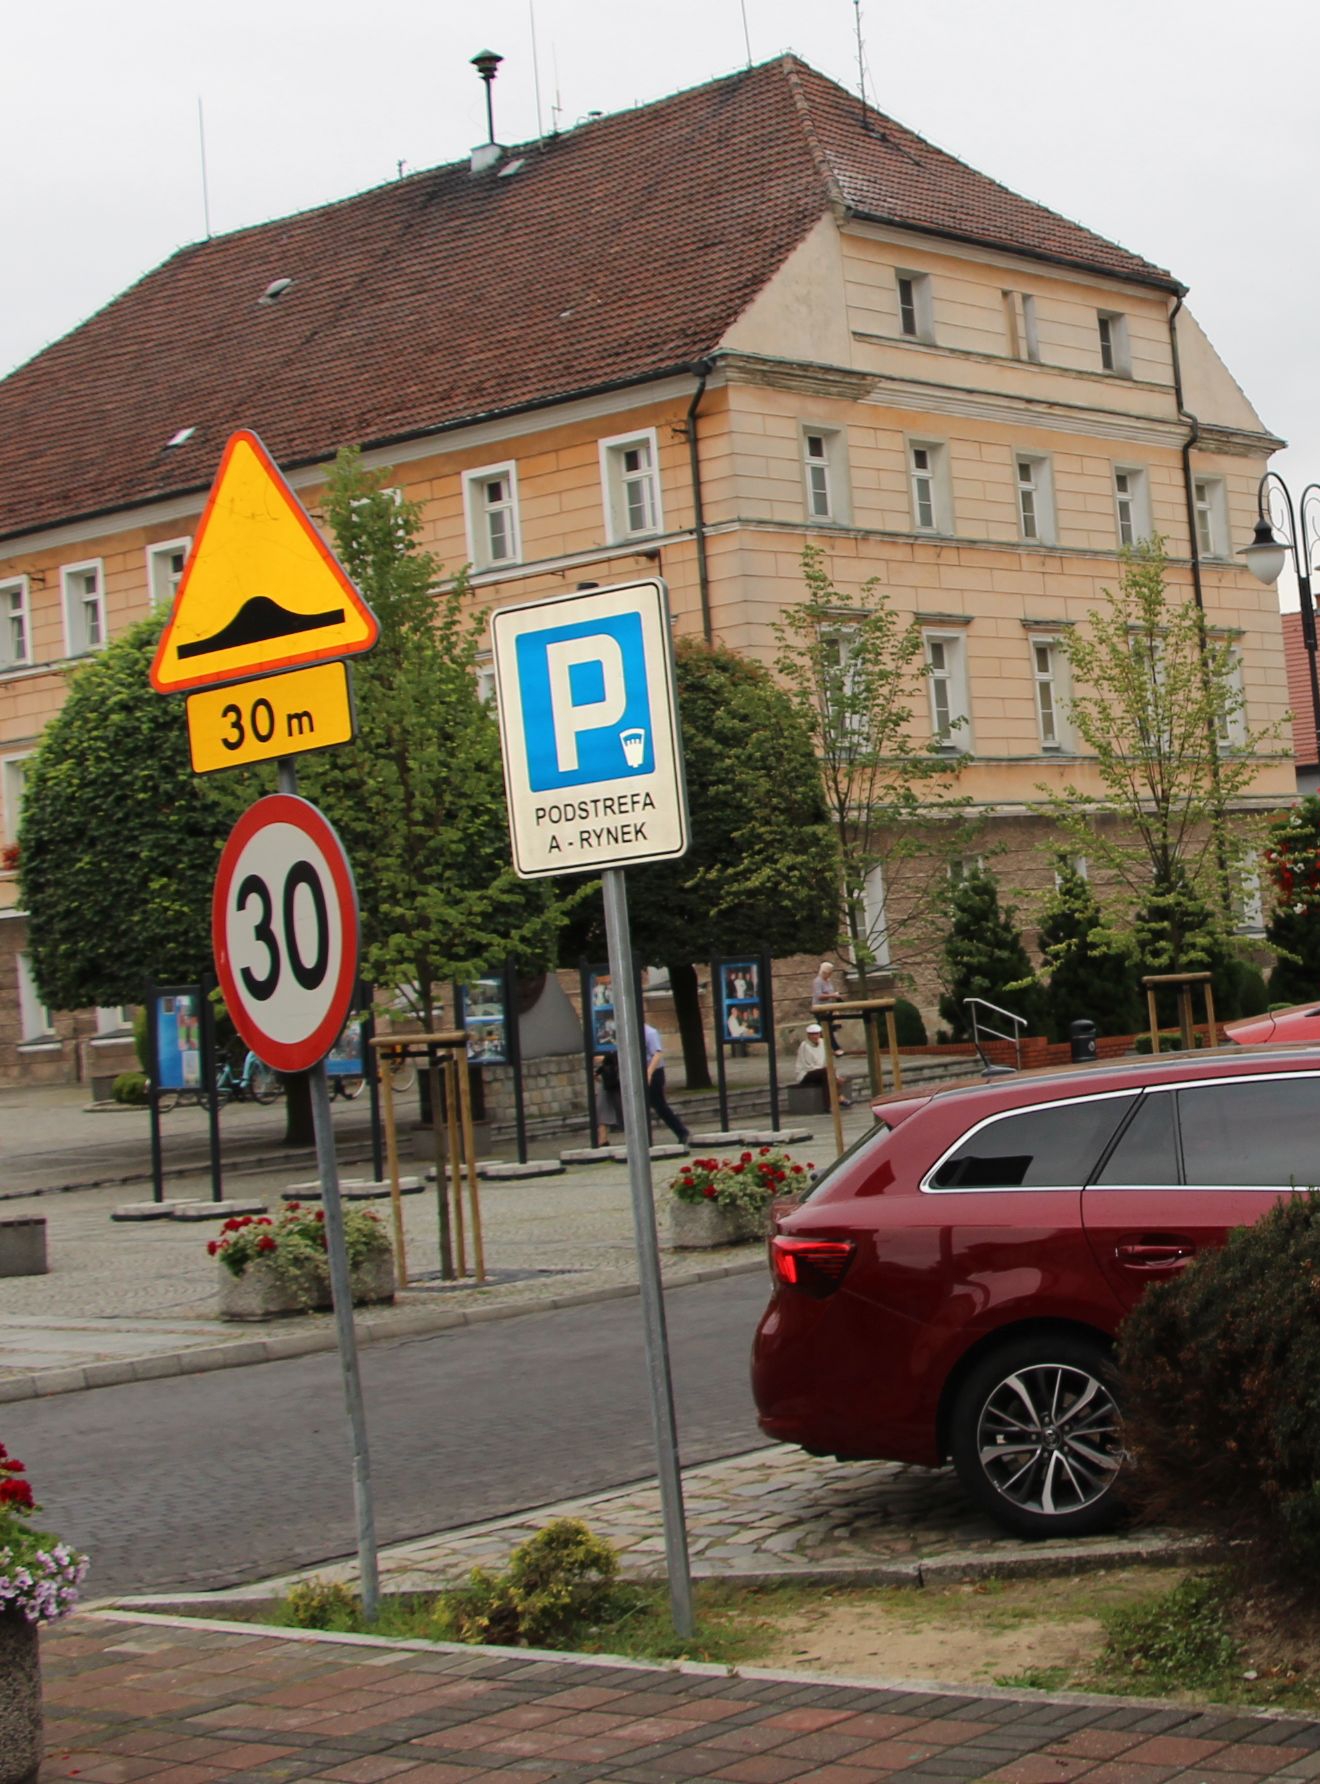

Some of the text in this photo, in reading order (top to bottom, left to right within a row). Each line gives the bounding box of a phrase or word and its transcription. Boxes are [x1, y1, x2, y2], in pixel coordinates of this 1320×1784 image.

[221, 697, 314, 751] 30 m
[546, 633, 627, 773] P
[535, 791, 656, 827] PODSTREFA
[548, 835, 562, 854] A
[579, 822, 648, 849] RYNEK
[236, 860, 330, 1001] 30
